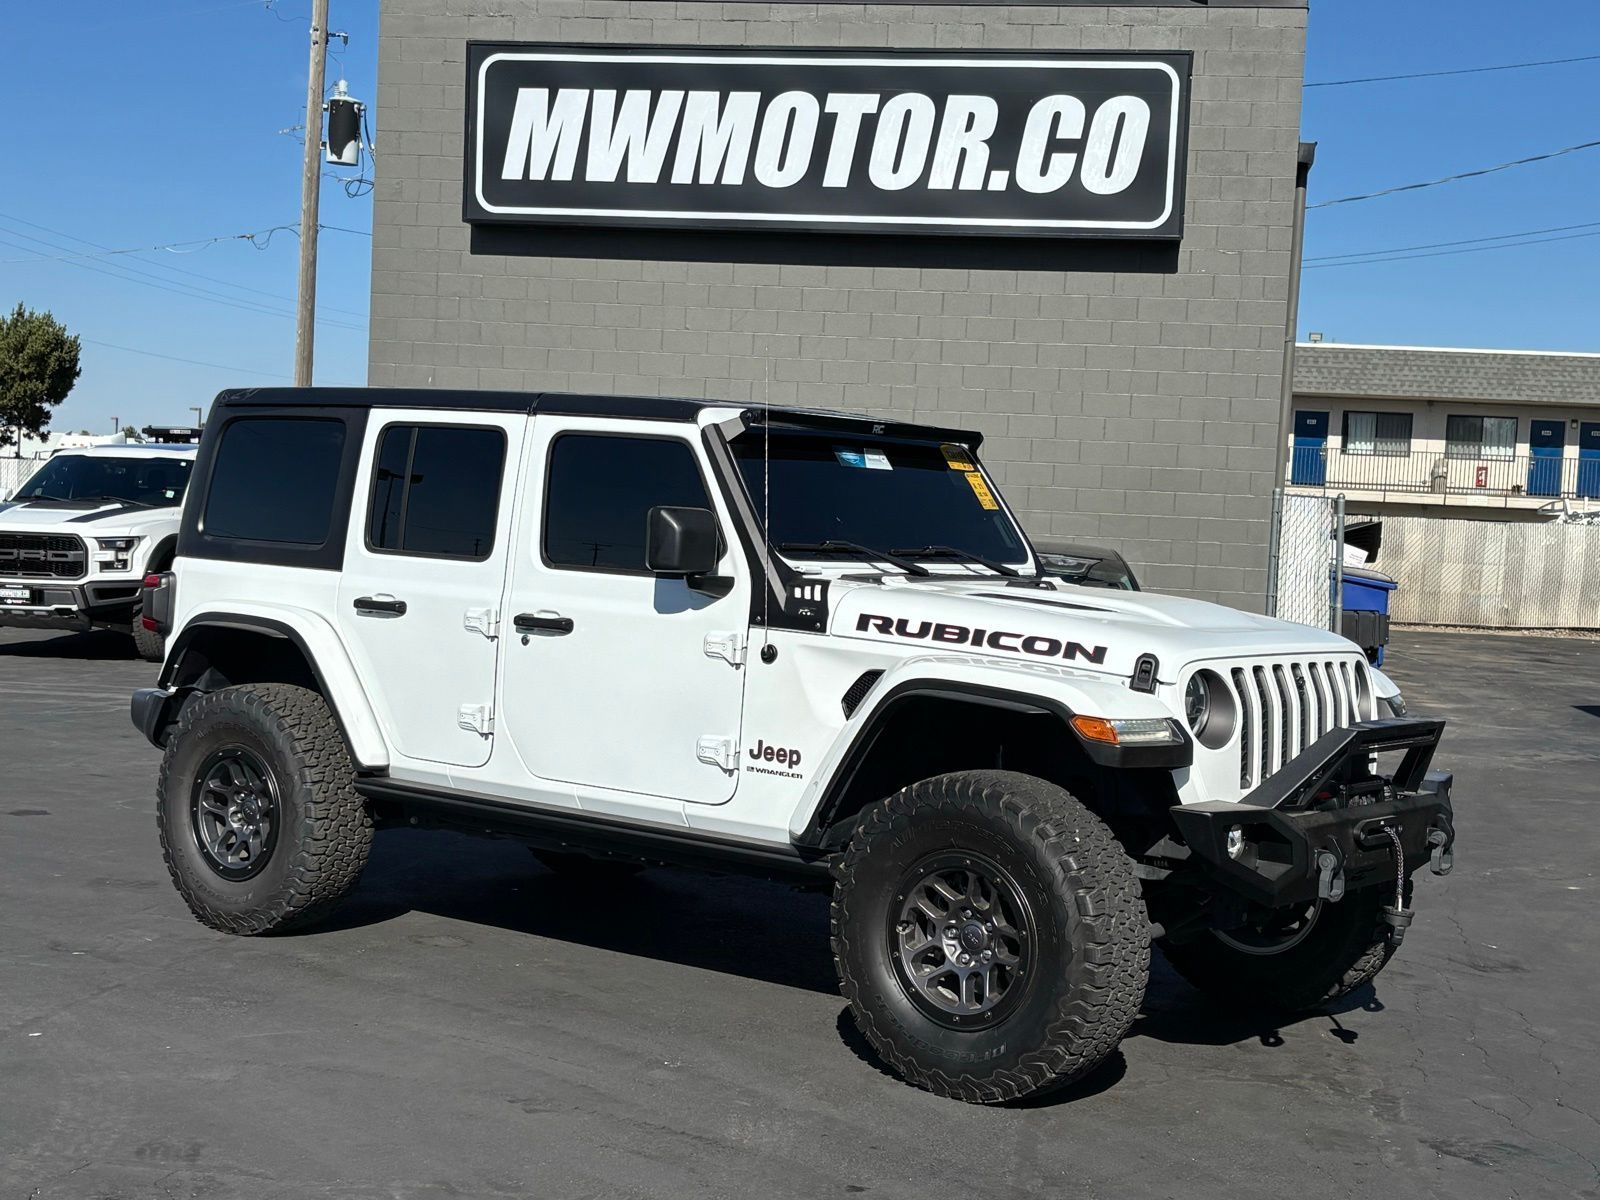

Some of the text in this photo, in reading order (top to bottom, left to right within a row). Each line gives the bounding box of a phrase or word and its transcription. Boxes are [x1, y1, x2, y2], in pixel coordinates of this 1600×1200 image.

[501, 87, 1151, 195] MWMOTOR.CO
[856, 613, 1108, 665] RUBICON
[749, 739, 801, 769] Jeep
[755, 767, 803, 779] WRANGLER
